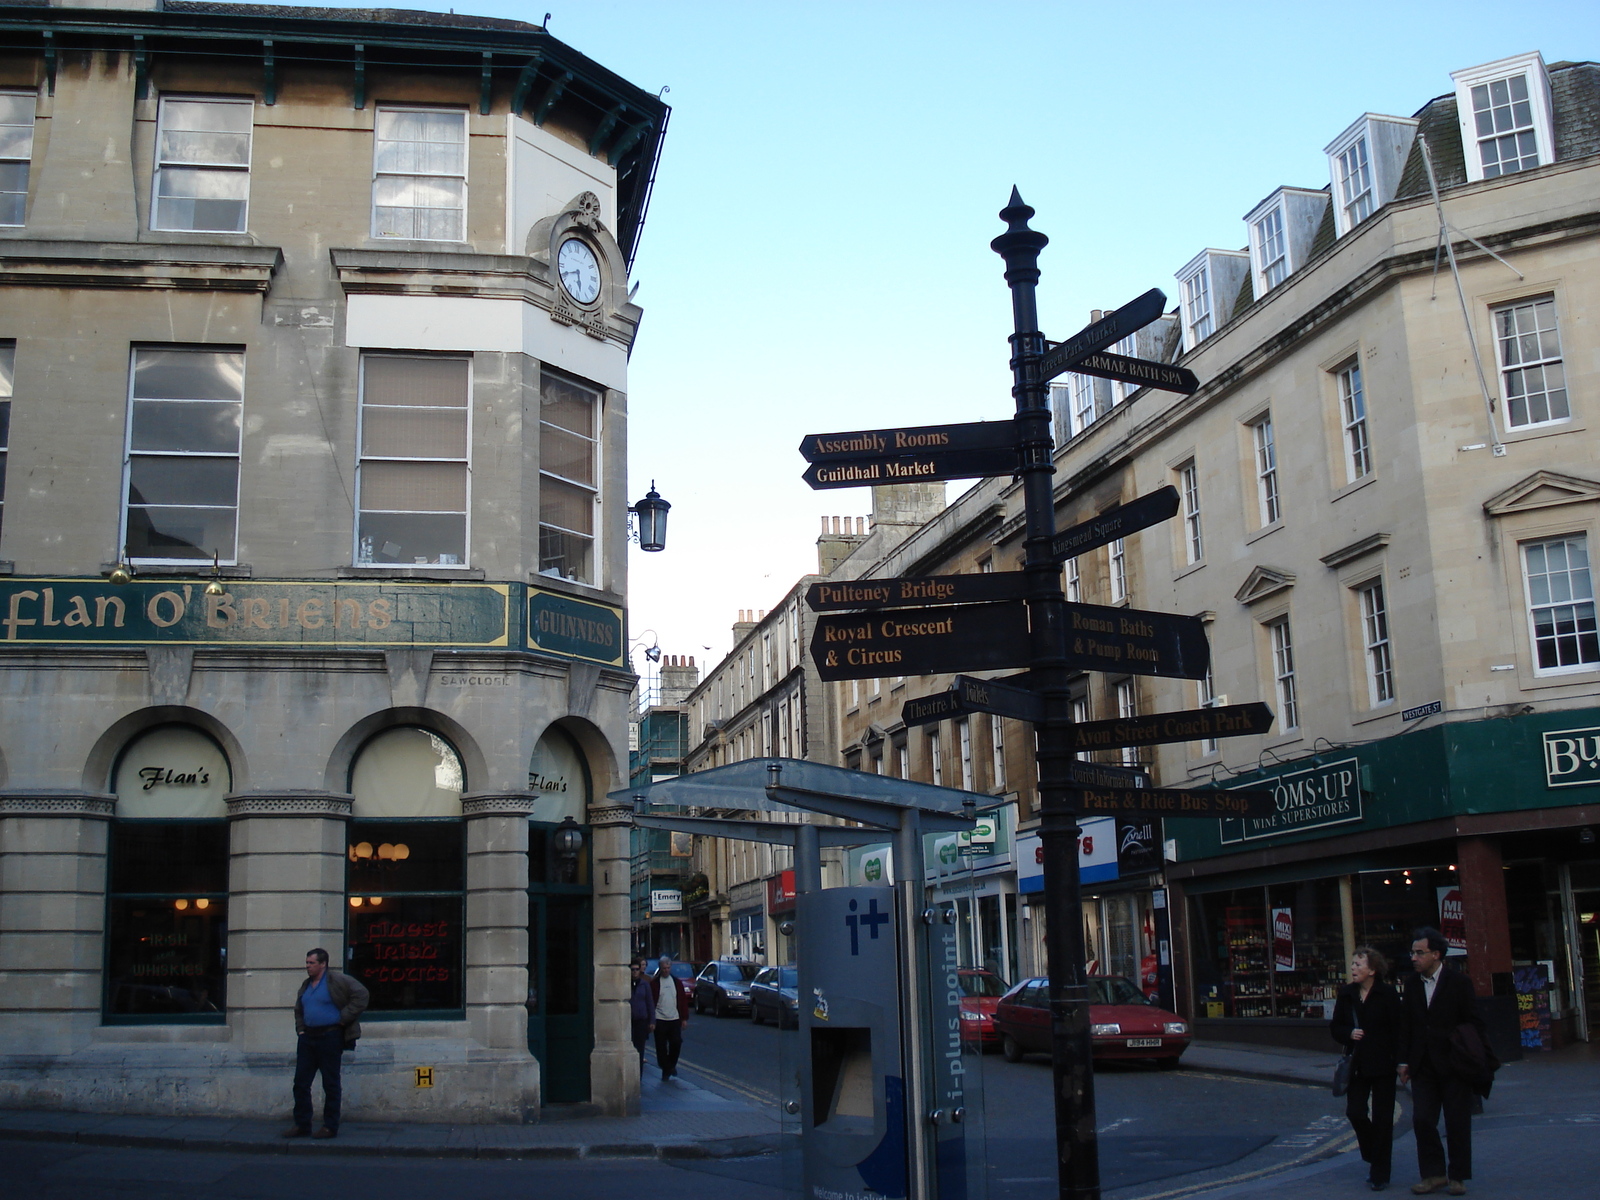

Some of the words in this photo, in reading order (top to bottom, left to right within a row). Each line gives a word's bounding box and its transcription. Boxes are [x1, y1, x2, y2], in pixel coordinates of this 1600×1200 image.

[1039, 355, 1063, 375] Green
[1064, 341, 1083, 360] Park
[1086, 319, 1118, 346] Market
[1080, 354, 1127, 374] ERMAE
[1129, 362, 1159, 381] BATH
[1161, 369, 1183, 386] SPA
[812, 433, 887, 454] Assembly
[895, 431, 949, 449] Rooms
[816, 464, 880, 483] Guildhall
[885, 461, 936, 478] Market
[1052, 525, 1092, 556] Kingsmead
[1094, 517, 1122, 539] Square
[818, 585, 891, 603] Pulteney
[899, 580, 955, 600] Bridge
[539, 608, 613, 647] GUINNESS
[824, 622, 873, 644] Royal
[881, 617, 954, 638] Crescent
[1072, 611, 1114, 634] Roman
[1120, 617, 1154, 638] Baths
[825, 649, 839, 667] &
[847, 647, 903, 666] Circus
[1073, 637, 1084, 655] &
[1087, 638, 1122, 662] Pump
[1126, 642, 1160, 662] Room
[964, 681, 989, 705] Toilets
[908, 699, 949, 719] Theatre
[1403, 705, 1432, 720] WESTGATE
[1075, 728, 1111, 747] Avon
[1114, 721, 1159, 743] Street
[1164, 714, 1210, 737] Coach
[1214, 709, 1253, 732] Park
[138, 766, 210, 790] Flan's
[529, 772, 567, 793] Flan's
[1071, 764, 1095, 784] Tourist
[1096, 768, 1135, 788] Information
[1083, 790, 1119, 809] Park
[1123, 791, 1136, 809] &
[1140, 791, 1175, 810] Ride
[1179, 793, 1209, 811] Bus
[1215, 793, 1249, 814] Stop
[1252, 814, 1278, 830] WINE
[1281, 800, 1351, 825] SUPERSTORES
[657, 893, 681, 901] Emery
[942, 933, 963, 1007] point
[945, 1017, 966, 1100] i-plus
[417, 1068, 432, 1086] H
[812, 1185, 843, 1200] Welcome
[845, 1191, 854, 1200] to
